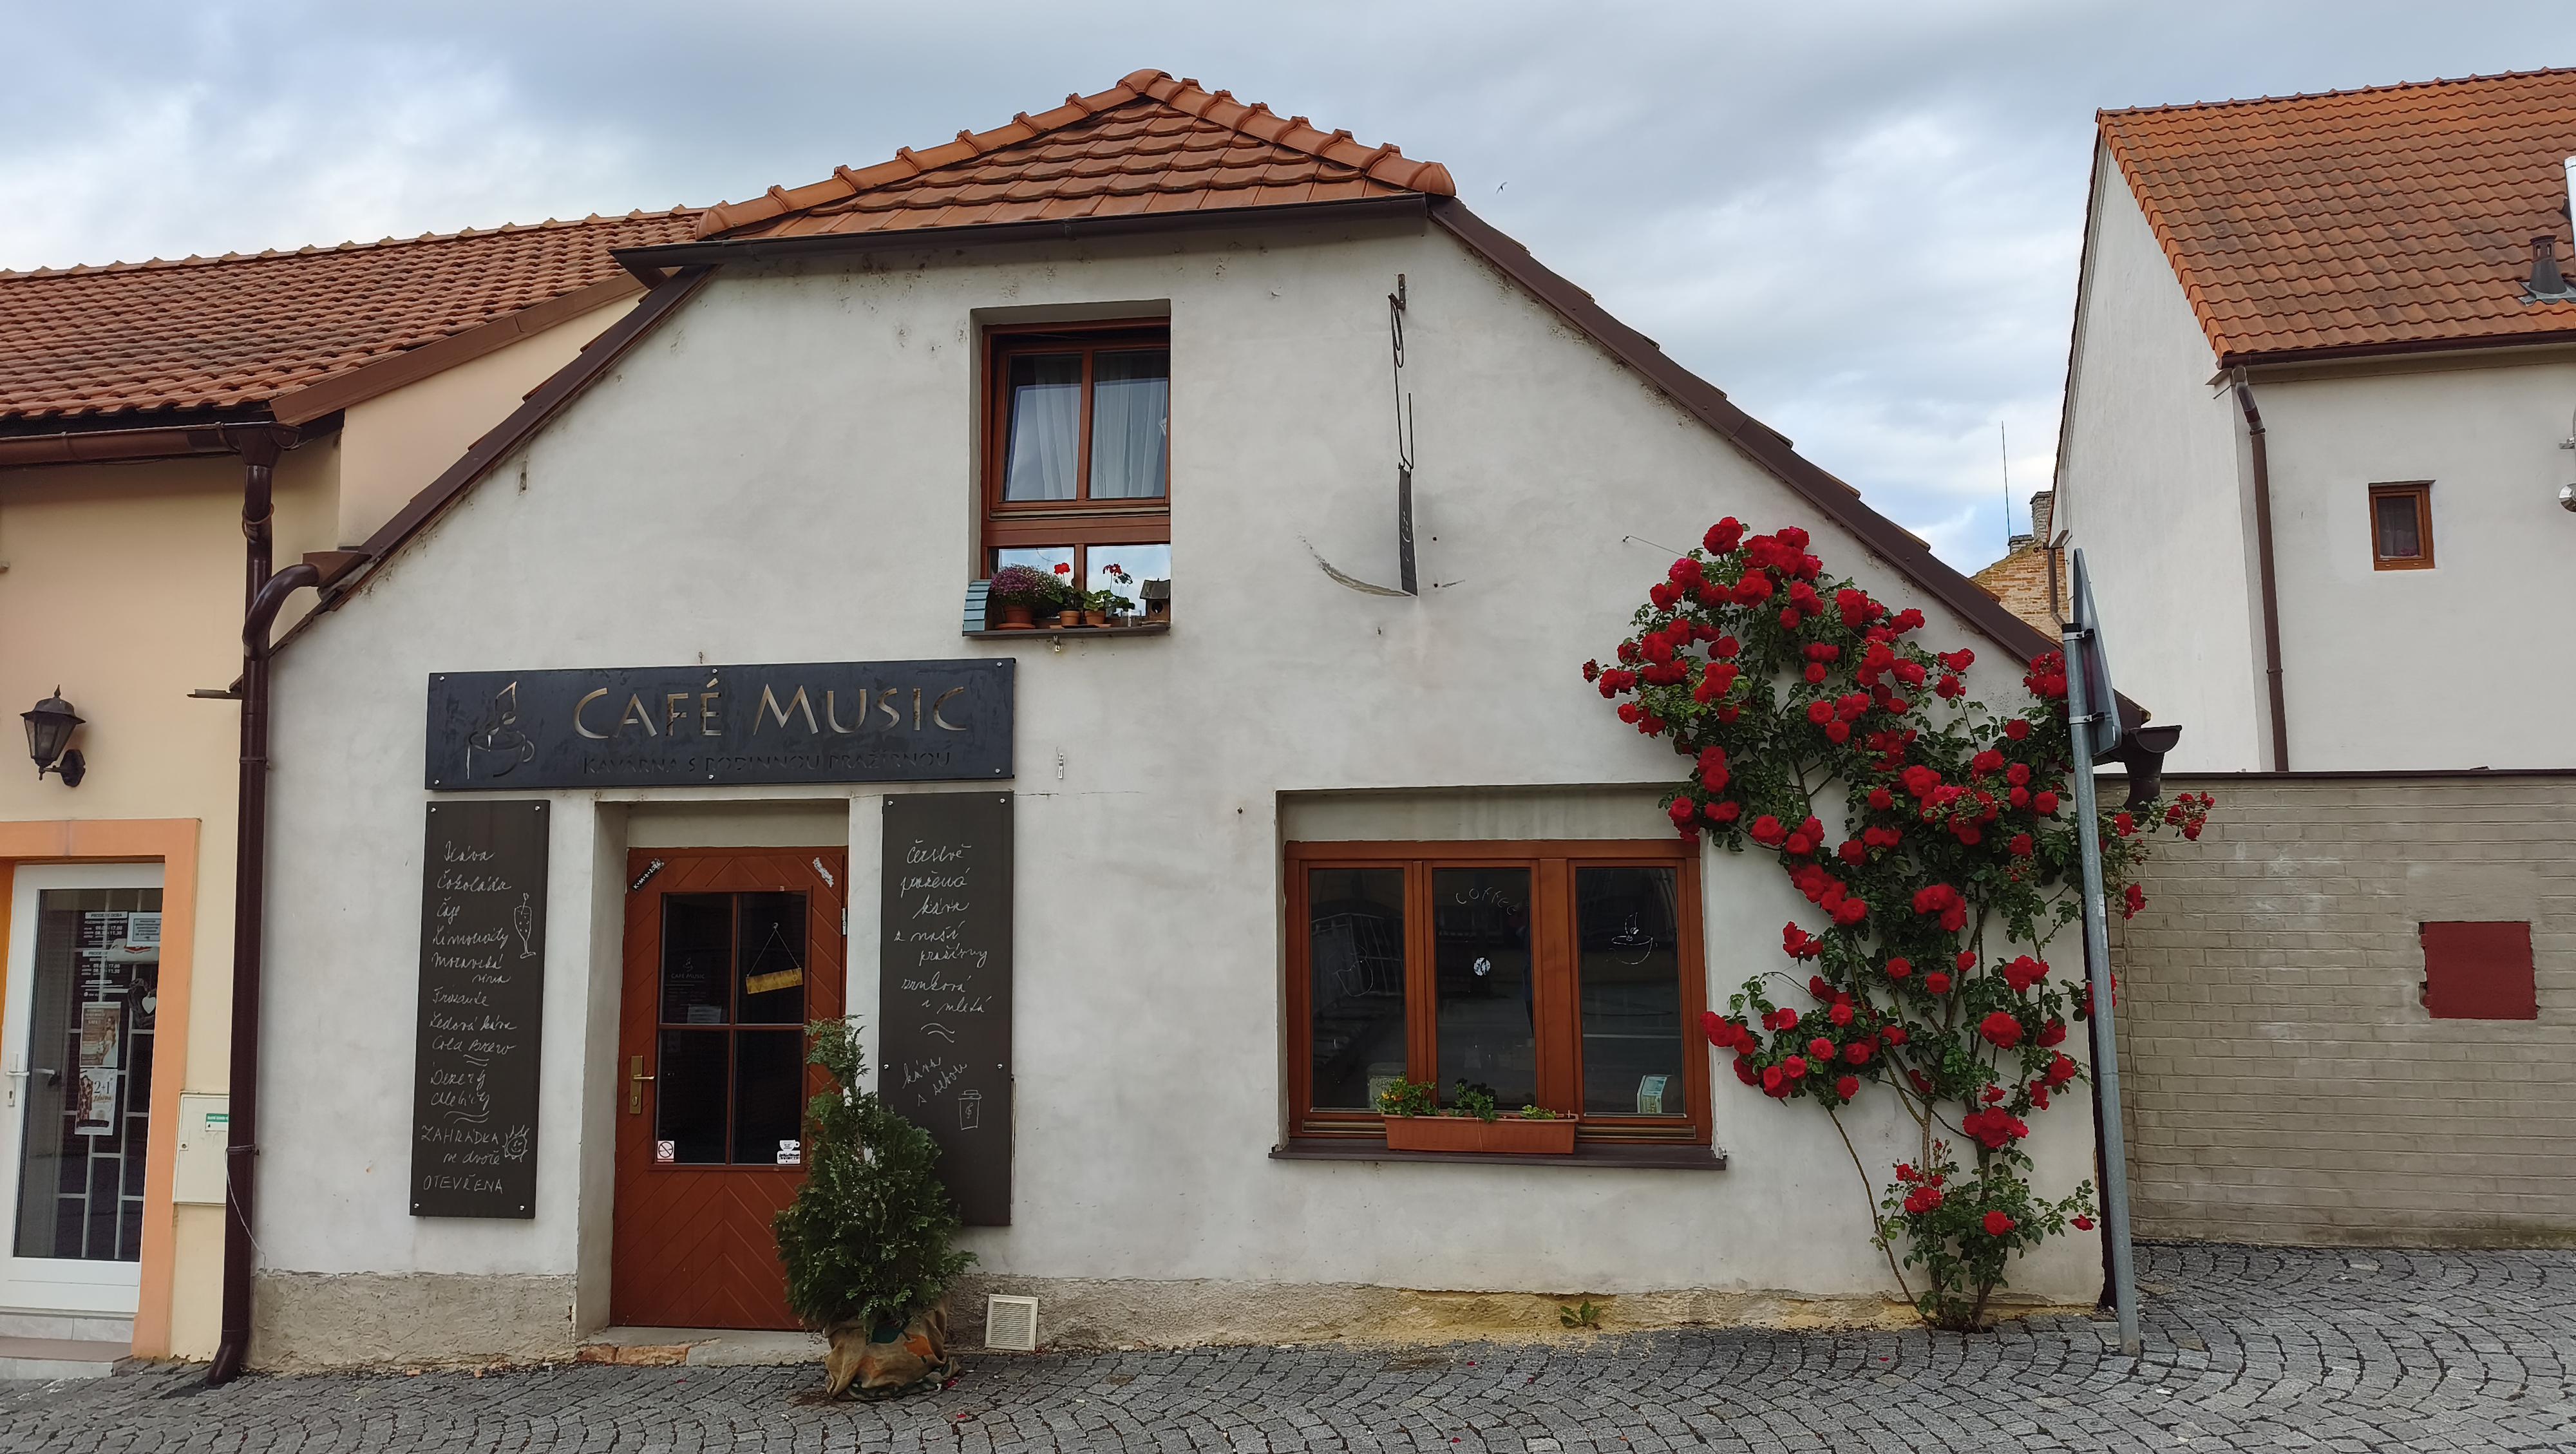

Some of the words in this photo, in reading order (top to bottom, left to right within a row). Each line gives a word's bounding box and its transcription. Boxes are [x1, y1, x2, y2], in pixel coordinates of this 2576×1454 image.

[573, 677, 722, 739] CAFÉ
[753, 684, 967, 735] MUSIC
[688, 757, 696, 772] S
[444, 840, 495, 862] Káva
[437, 868, 512, 892] Čokoláda
[936, 996, 992, 1015] mletá
[429, 1011, 478, 1031] Ledová
[479, 1014, 517, 1031] káva
[421, 1125, 499, 1145] ZAHRÁDKA
[423, 1173, 503, 1194] OTEVŘENA
